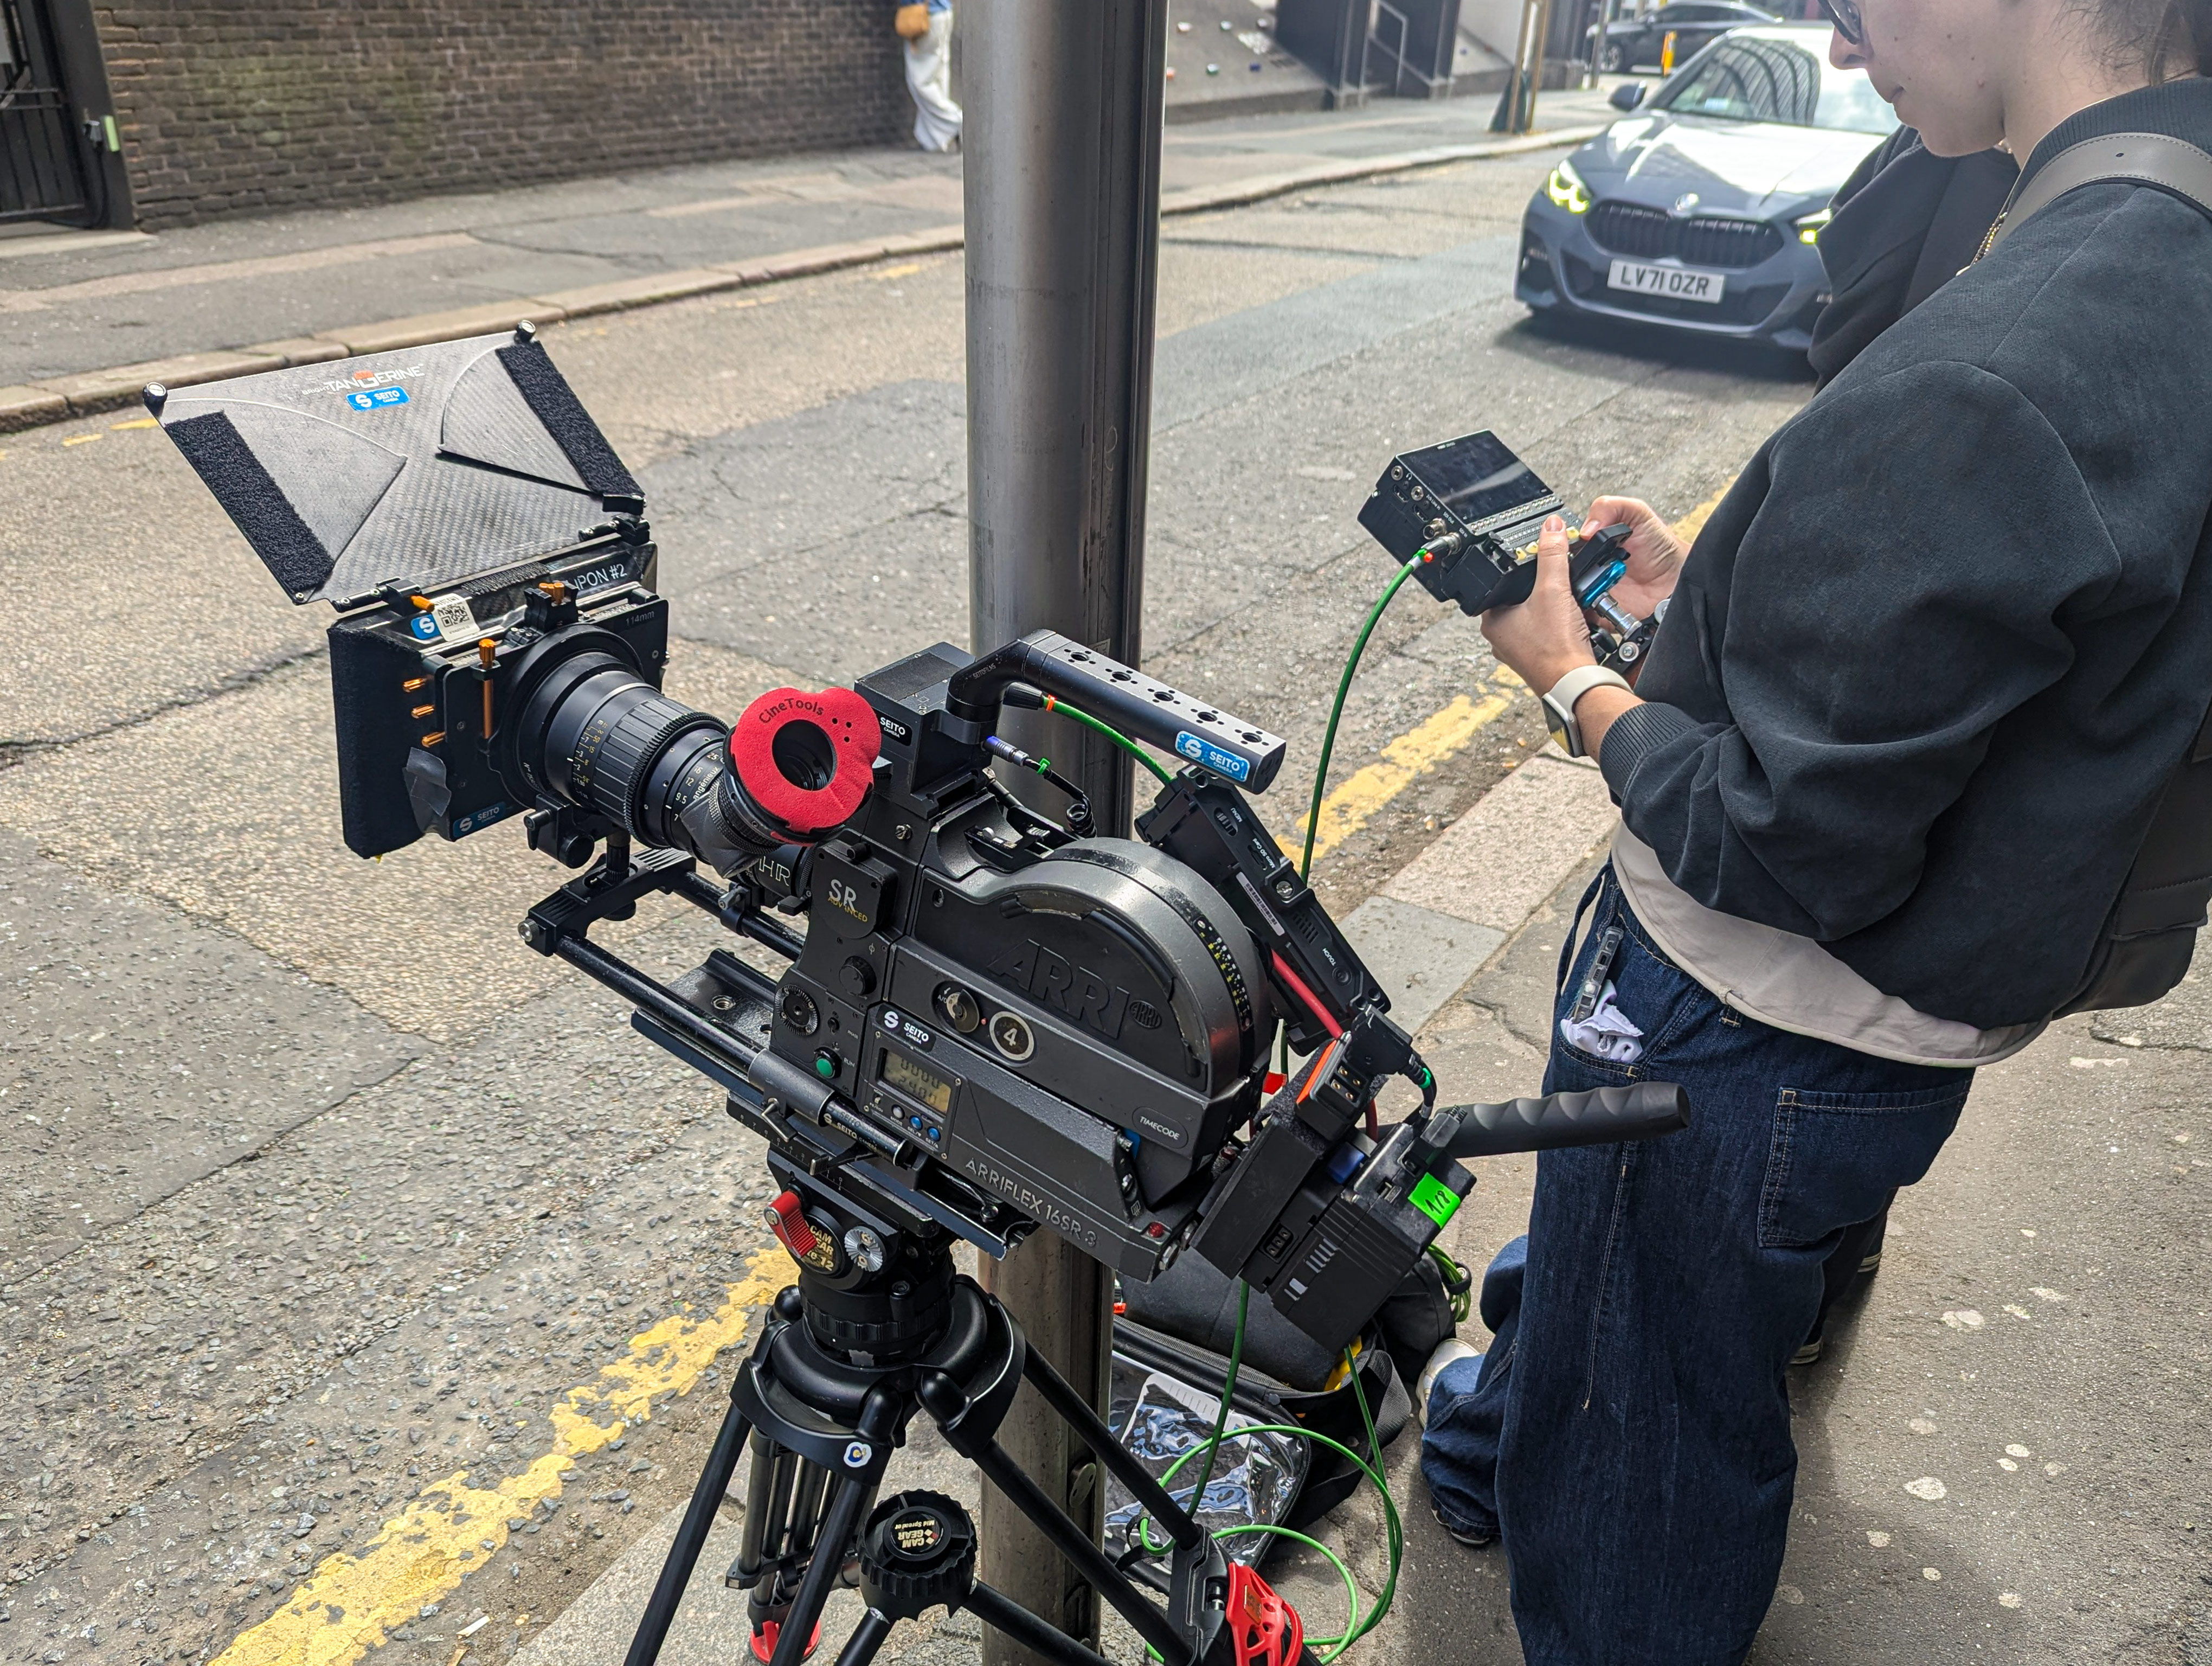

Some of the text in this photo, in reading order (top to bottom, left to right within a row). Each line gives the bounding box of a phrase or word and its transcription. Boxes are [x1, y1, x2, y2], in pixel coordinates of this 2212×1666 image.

[1621, 265, 1709, 296] LV71 OZR
[301, 366, 426, 395] BRIGHT TANGERINE
[374, 389, 401, 401] SEITO
[609, 563, 628, 580] #2
[626, 611, 655, 626] 114mm
[758, 697, 824, 723] CineTools
[880, 717, 906, 736] SEITO
[706, 752, 719, 760] 25
[1208, 751, 1240, 772] SEITO
[1213, 761, 1233, 774] CAMERA
[685, 777, 694, 787] 12
[675, 792, 687, 804] 9.5
[477, 806, 499, 821] SEITO
[674, 813, 679, 822] 7
[1230, 808, 1243, 823] MENU
[1252, 838, 1276, 868] Micro SD Card
[828, 879, 857, 913] SR
[827, 896, 868, 922] ADVANCED
[1322, 947, 1336, 966] TOUCH
[987, 938, 1130, 1040] ARRI
[903, 1022, 929, 1042] SEITO
[905, 1032, 922, 1045] CAMERA
[1003, 1028, 1018, 1047] 4
[844, 1057, 856, 1068] RUN
[837, 1122, 857, 1139] SEITO
[1140, 1116, 1180, 1140] TIMECODE
[965, 1157, 1043, 1215] ARRIFLEX
[1045, 1204, 1082, 1241] 16SR
[810, 1225, 833, 1245] CAM
[815, 1237, 834, 1256] EAR
[895, 1521, 922, 1530] Spreader
[898, 1529, 924, 1541] GEAR
[902, 1537, 925, 1548] CAM
